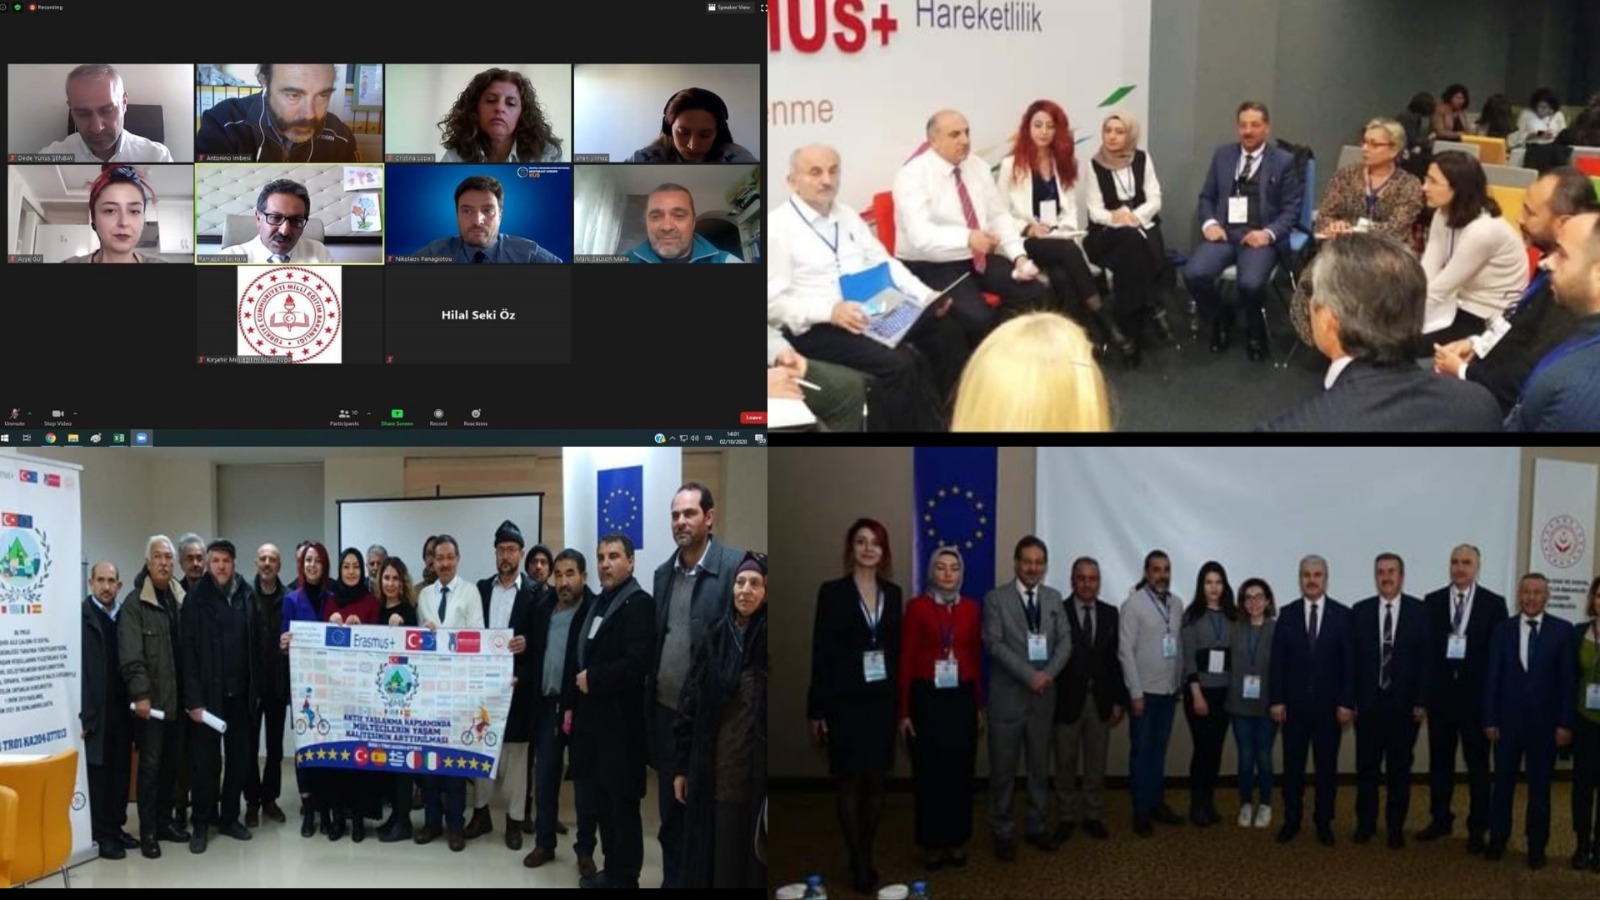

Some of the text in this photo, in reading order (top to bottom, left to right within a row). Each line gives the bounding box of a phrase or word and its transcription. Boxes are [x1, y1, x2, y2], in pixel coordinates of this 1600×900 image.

[916, 0, 1042, 32] Hareketlilik
[768, 99, 834, 126] nme
[287, 283, 307, 293] MİLLİ
[258, 285, 286, 322] CUMHURİYETİ
[307, 291, 323, 313] EĞİTİM
[441, 308, 516, 320] Hilal Seki Öz
[259, 324, 283, 345] TÜRKİYE
[354, 633, 395, 649] Erasmus+
